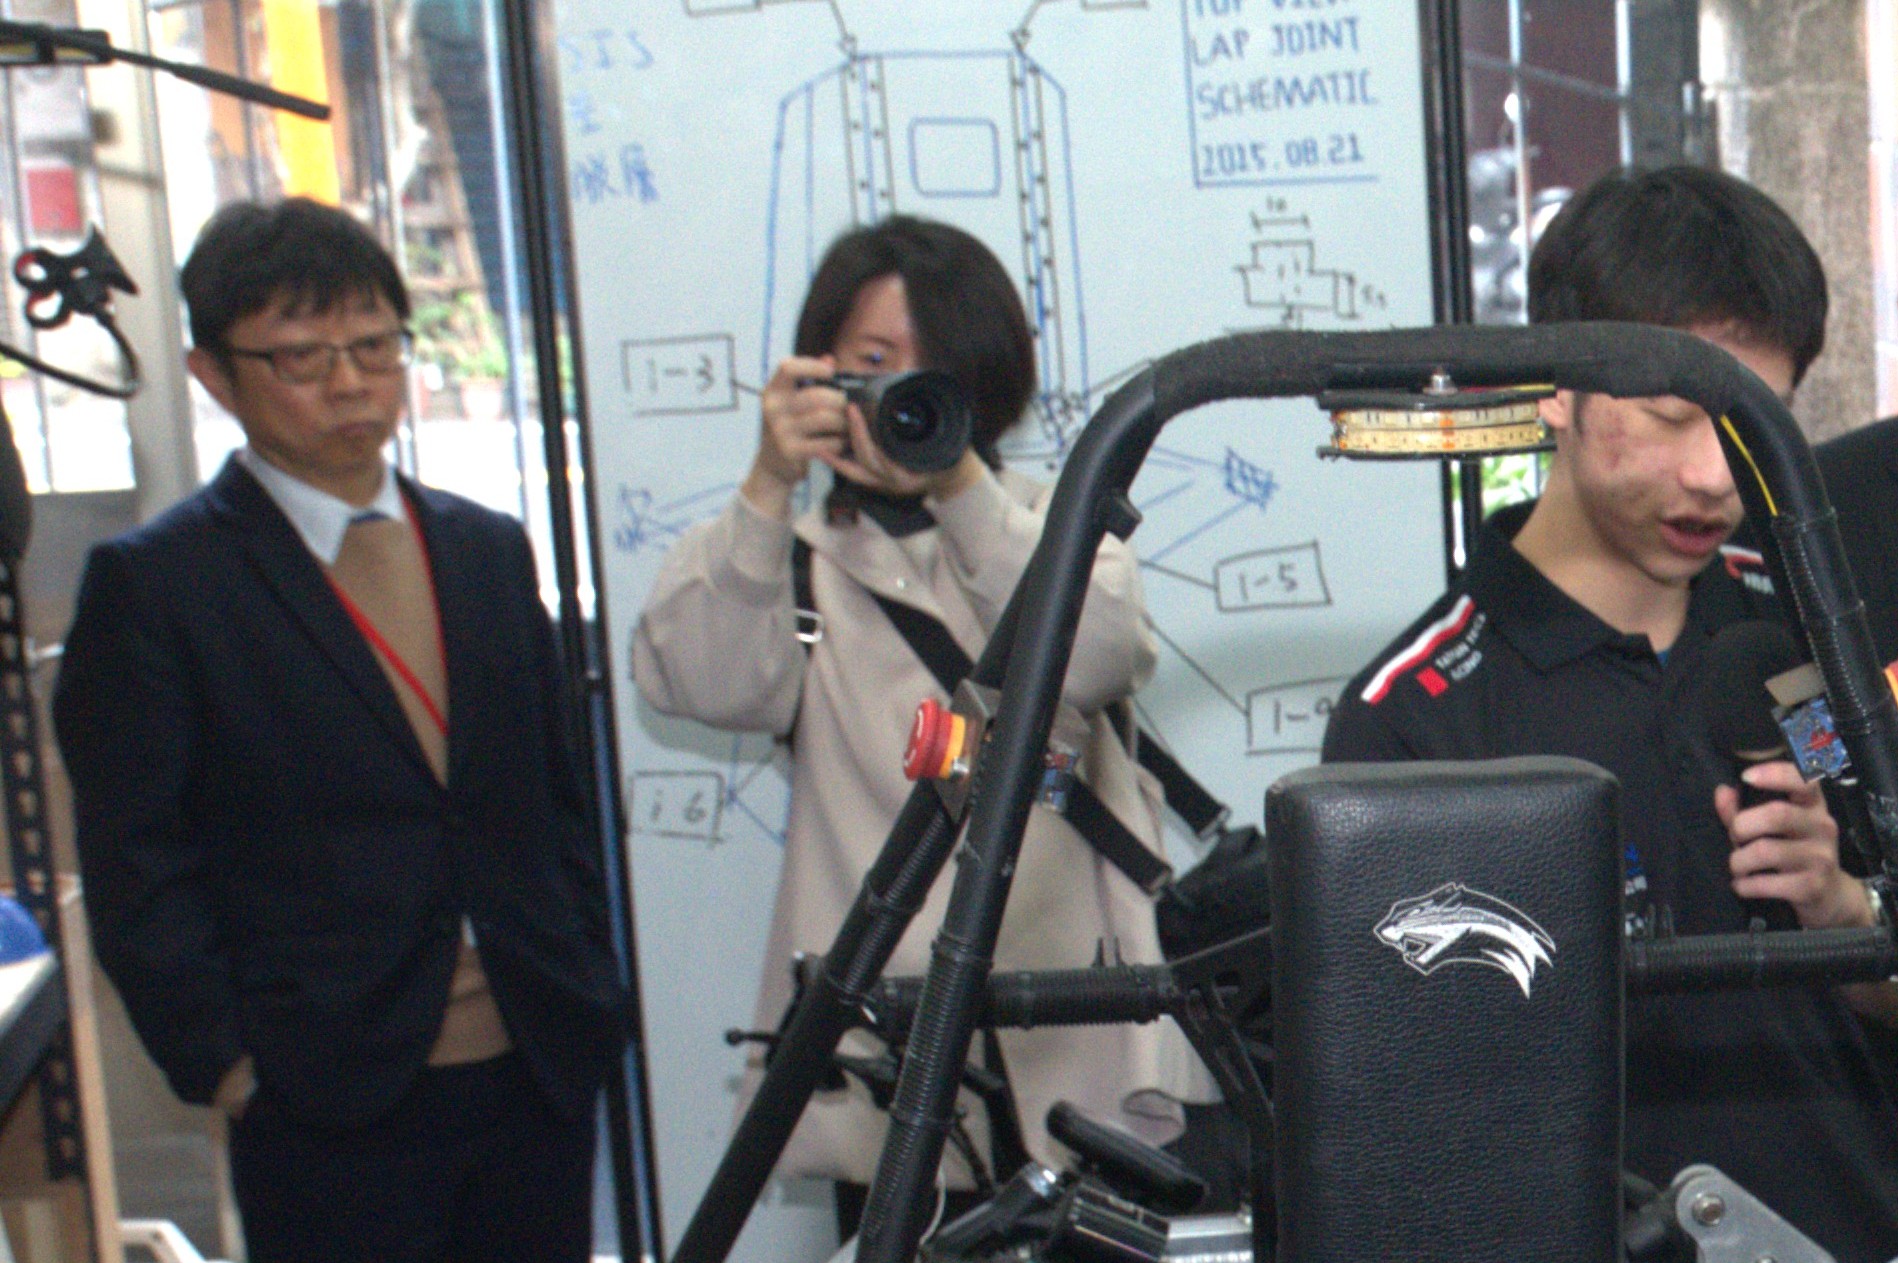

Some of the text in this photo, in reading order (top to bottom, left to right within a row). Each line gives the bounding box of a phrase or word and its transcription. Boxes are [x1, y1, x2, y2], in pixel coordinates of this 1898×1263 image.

[1190, 16, 1359, 67] LAP JOINT
[1197, 67, 1377, 121] SCHEMATIC
